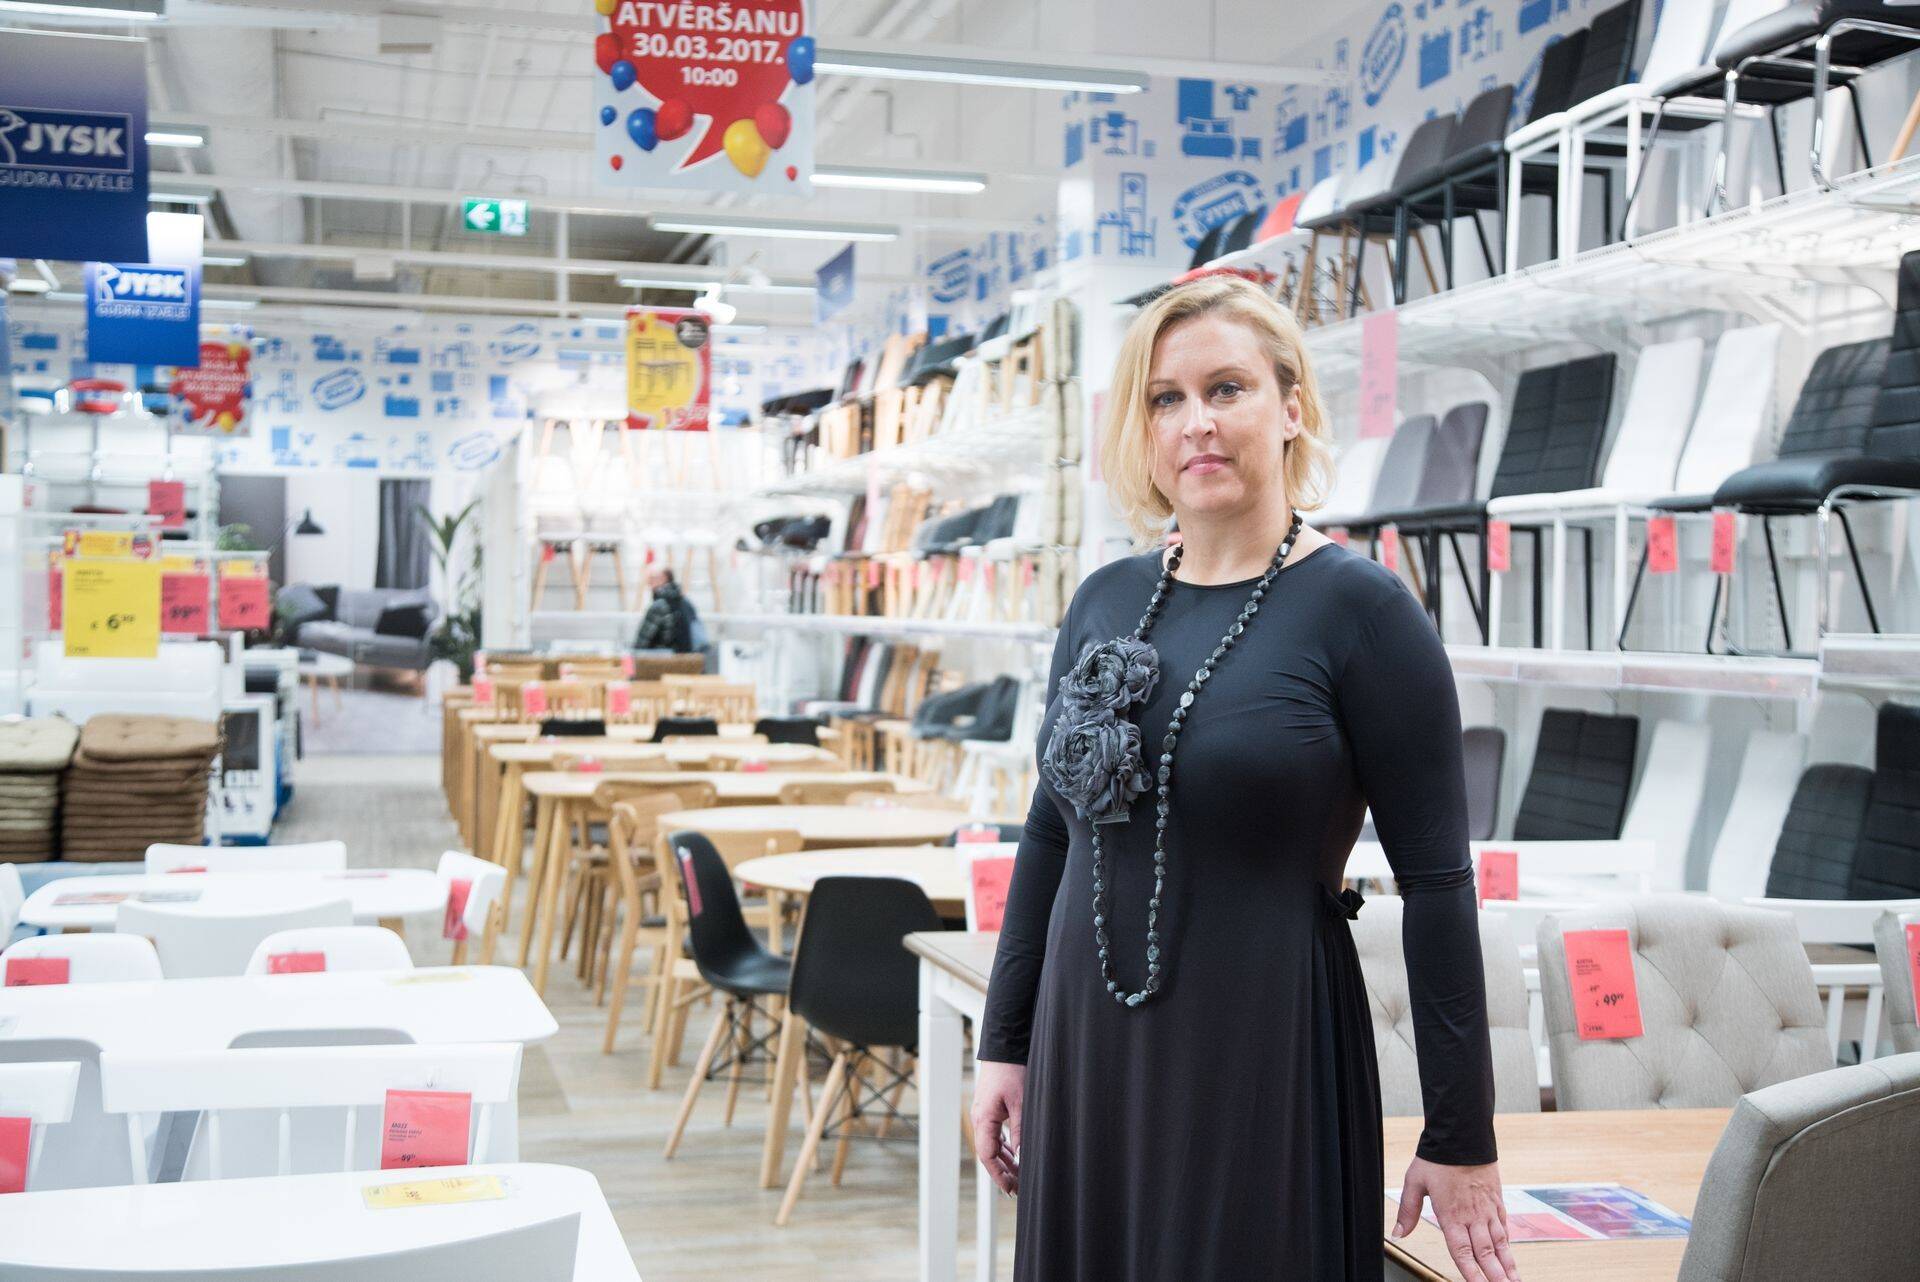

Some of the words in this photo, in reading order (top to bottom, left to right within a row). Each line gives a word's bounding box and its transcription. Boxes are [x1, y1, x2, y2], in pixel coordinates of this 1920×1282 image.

[616, 1, 798, 36] ATVĒRŠANU
[632, 33, 785, 64] 30.03.2017.
[681, 67, 738, 87] 10:00
[23, 123, 125, 156] JYSK
[115, 272, 184, 297] JYSK
